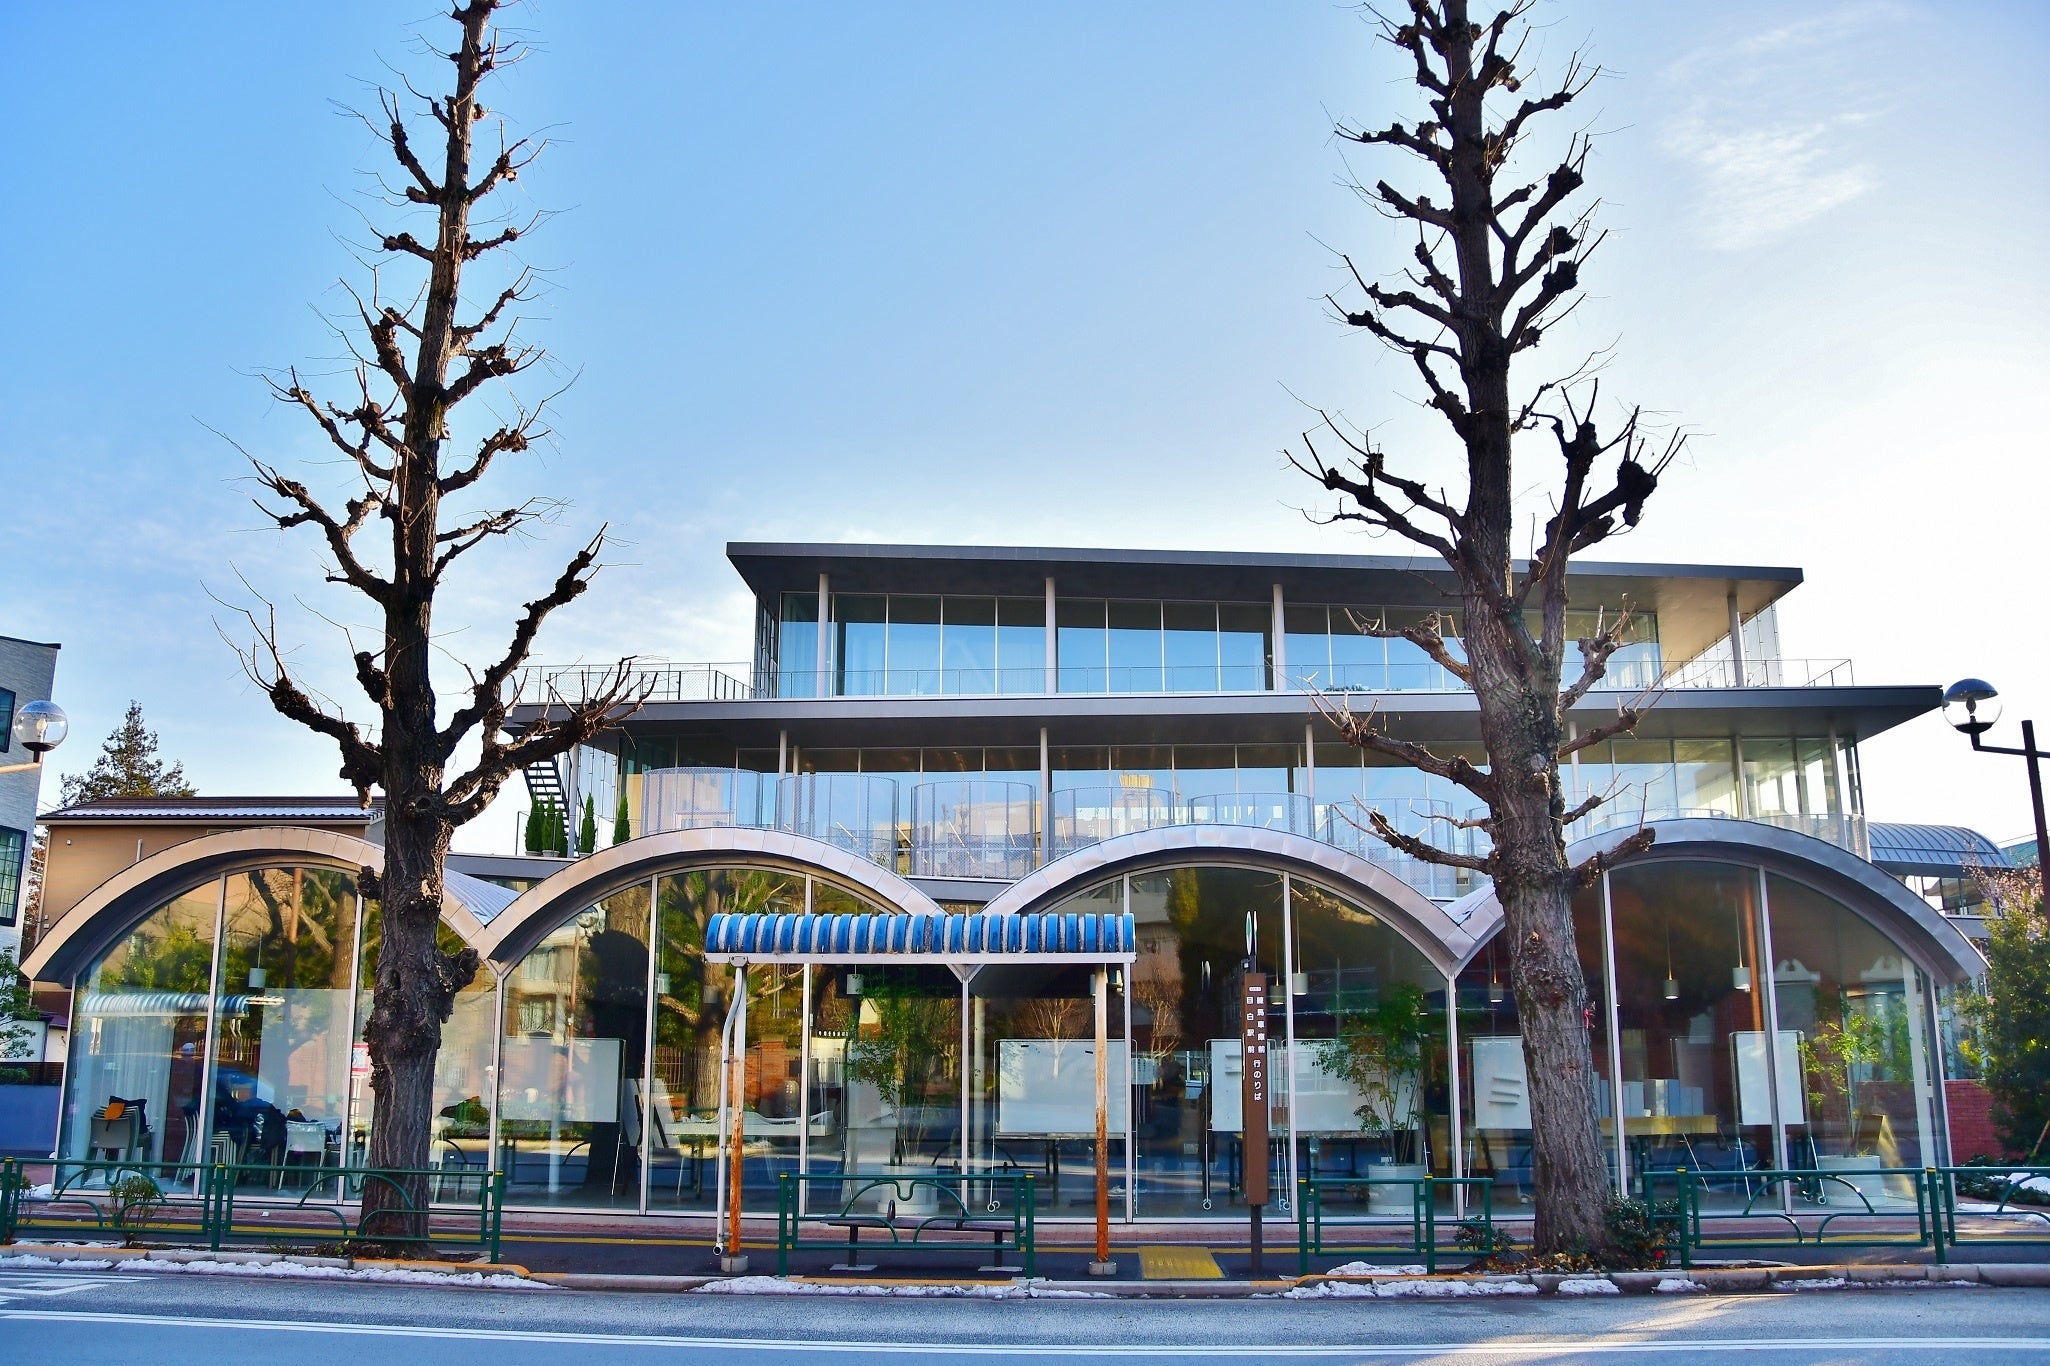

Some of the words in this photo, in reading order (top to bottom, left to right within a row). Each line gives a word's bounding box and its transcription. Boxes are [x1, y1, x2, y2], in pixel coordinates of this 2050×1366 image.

[1246, 996, 1255, 1054] 目白駅前
[1253, 1059, 1262, 1101] 行のりば
